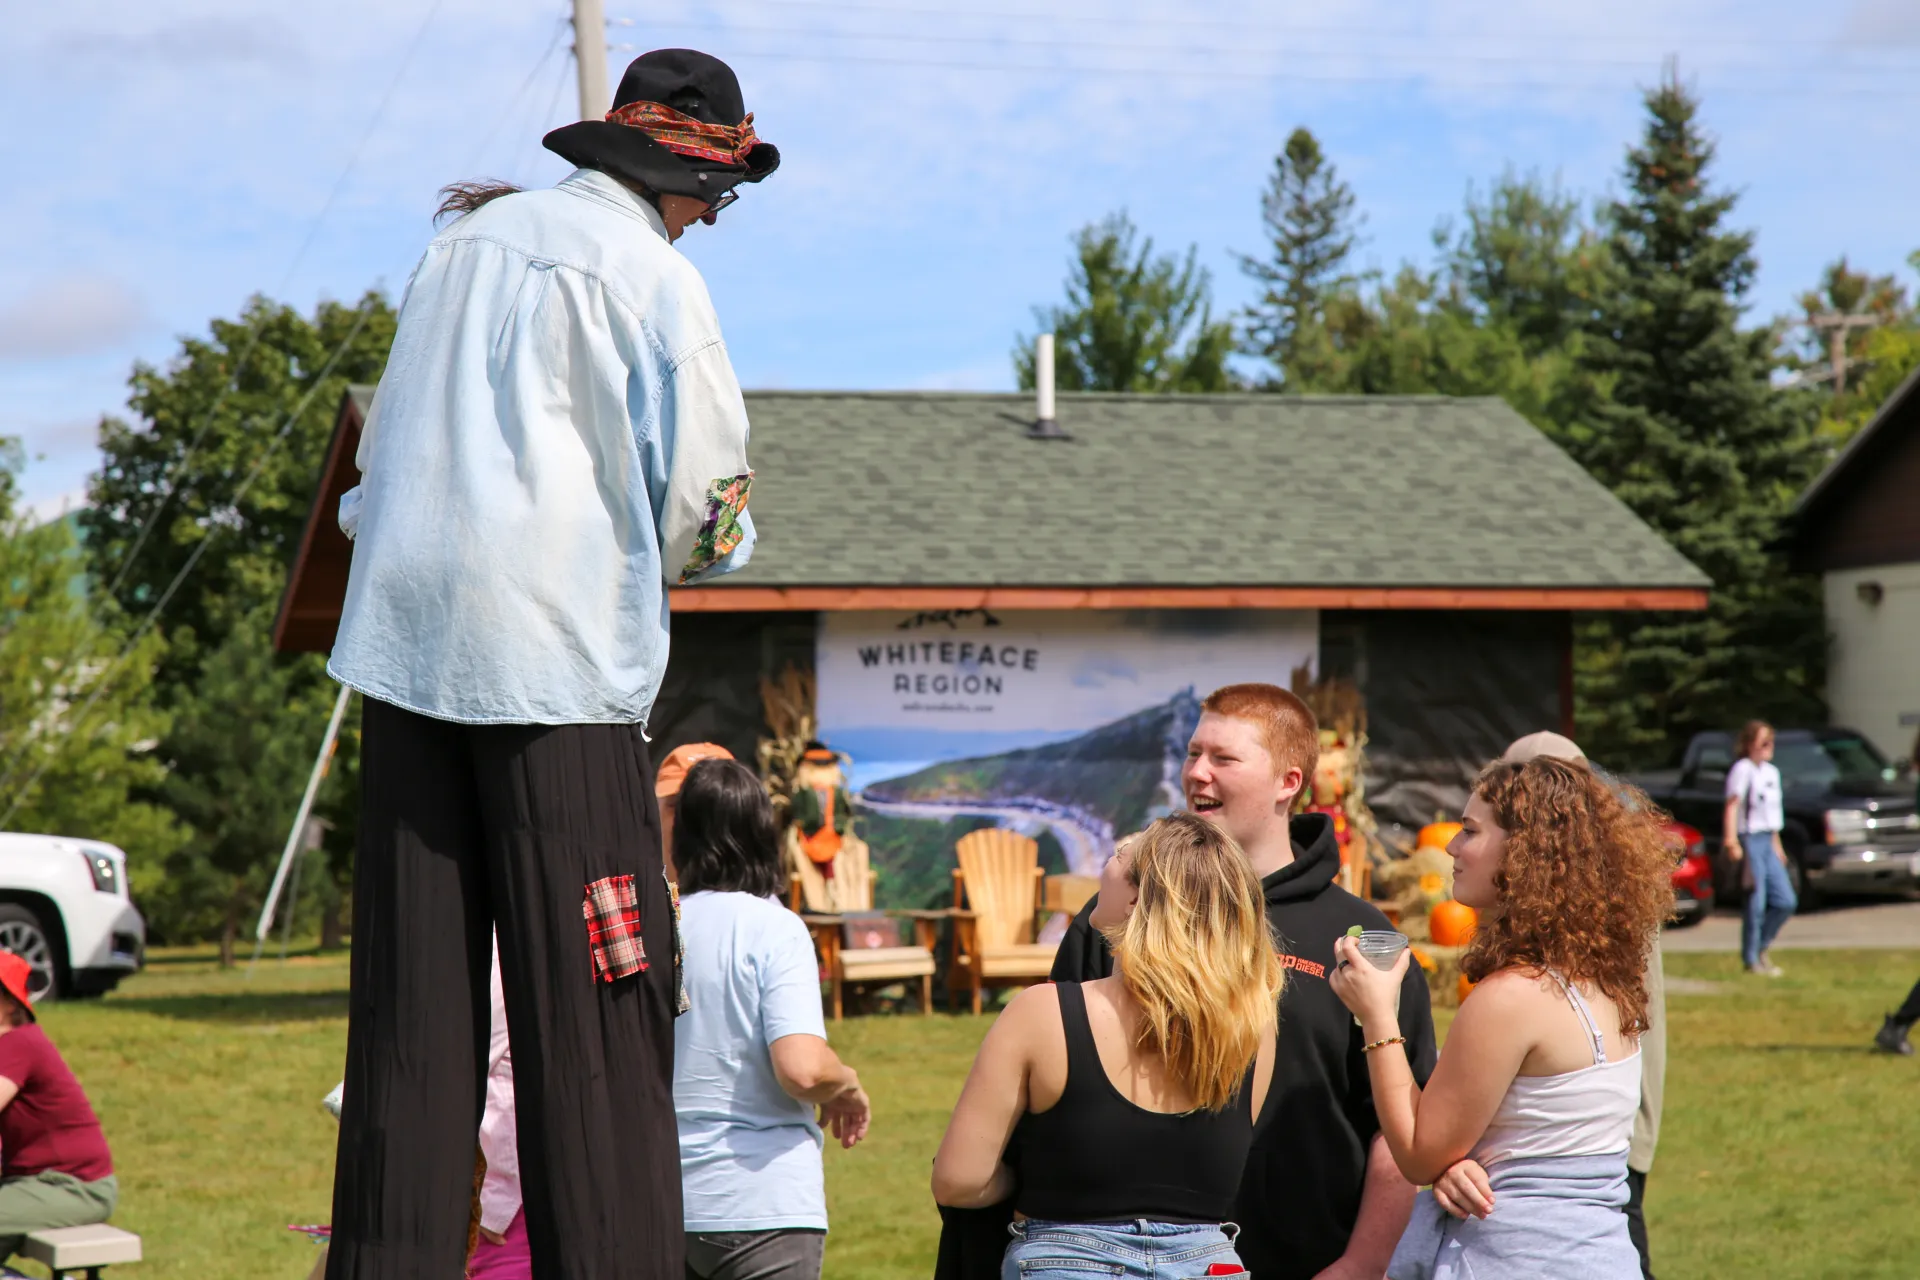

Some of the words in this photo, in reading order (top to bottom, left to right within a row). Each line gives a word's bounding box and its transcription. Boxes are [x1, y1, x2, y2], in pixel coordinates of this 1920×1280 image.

[859, 641, 1039, 671] WHITEFACE
[894, 673, 1002, 694] REGION
[1296, 963, 1326, 979] DIESEL
